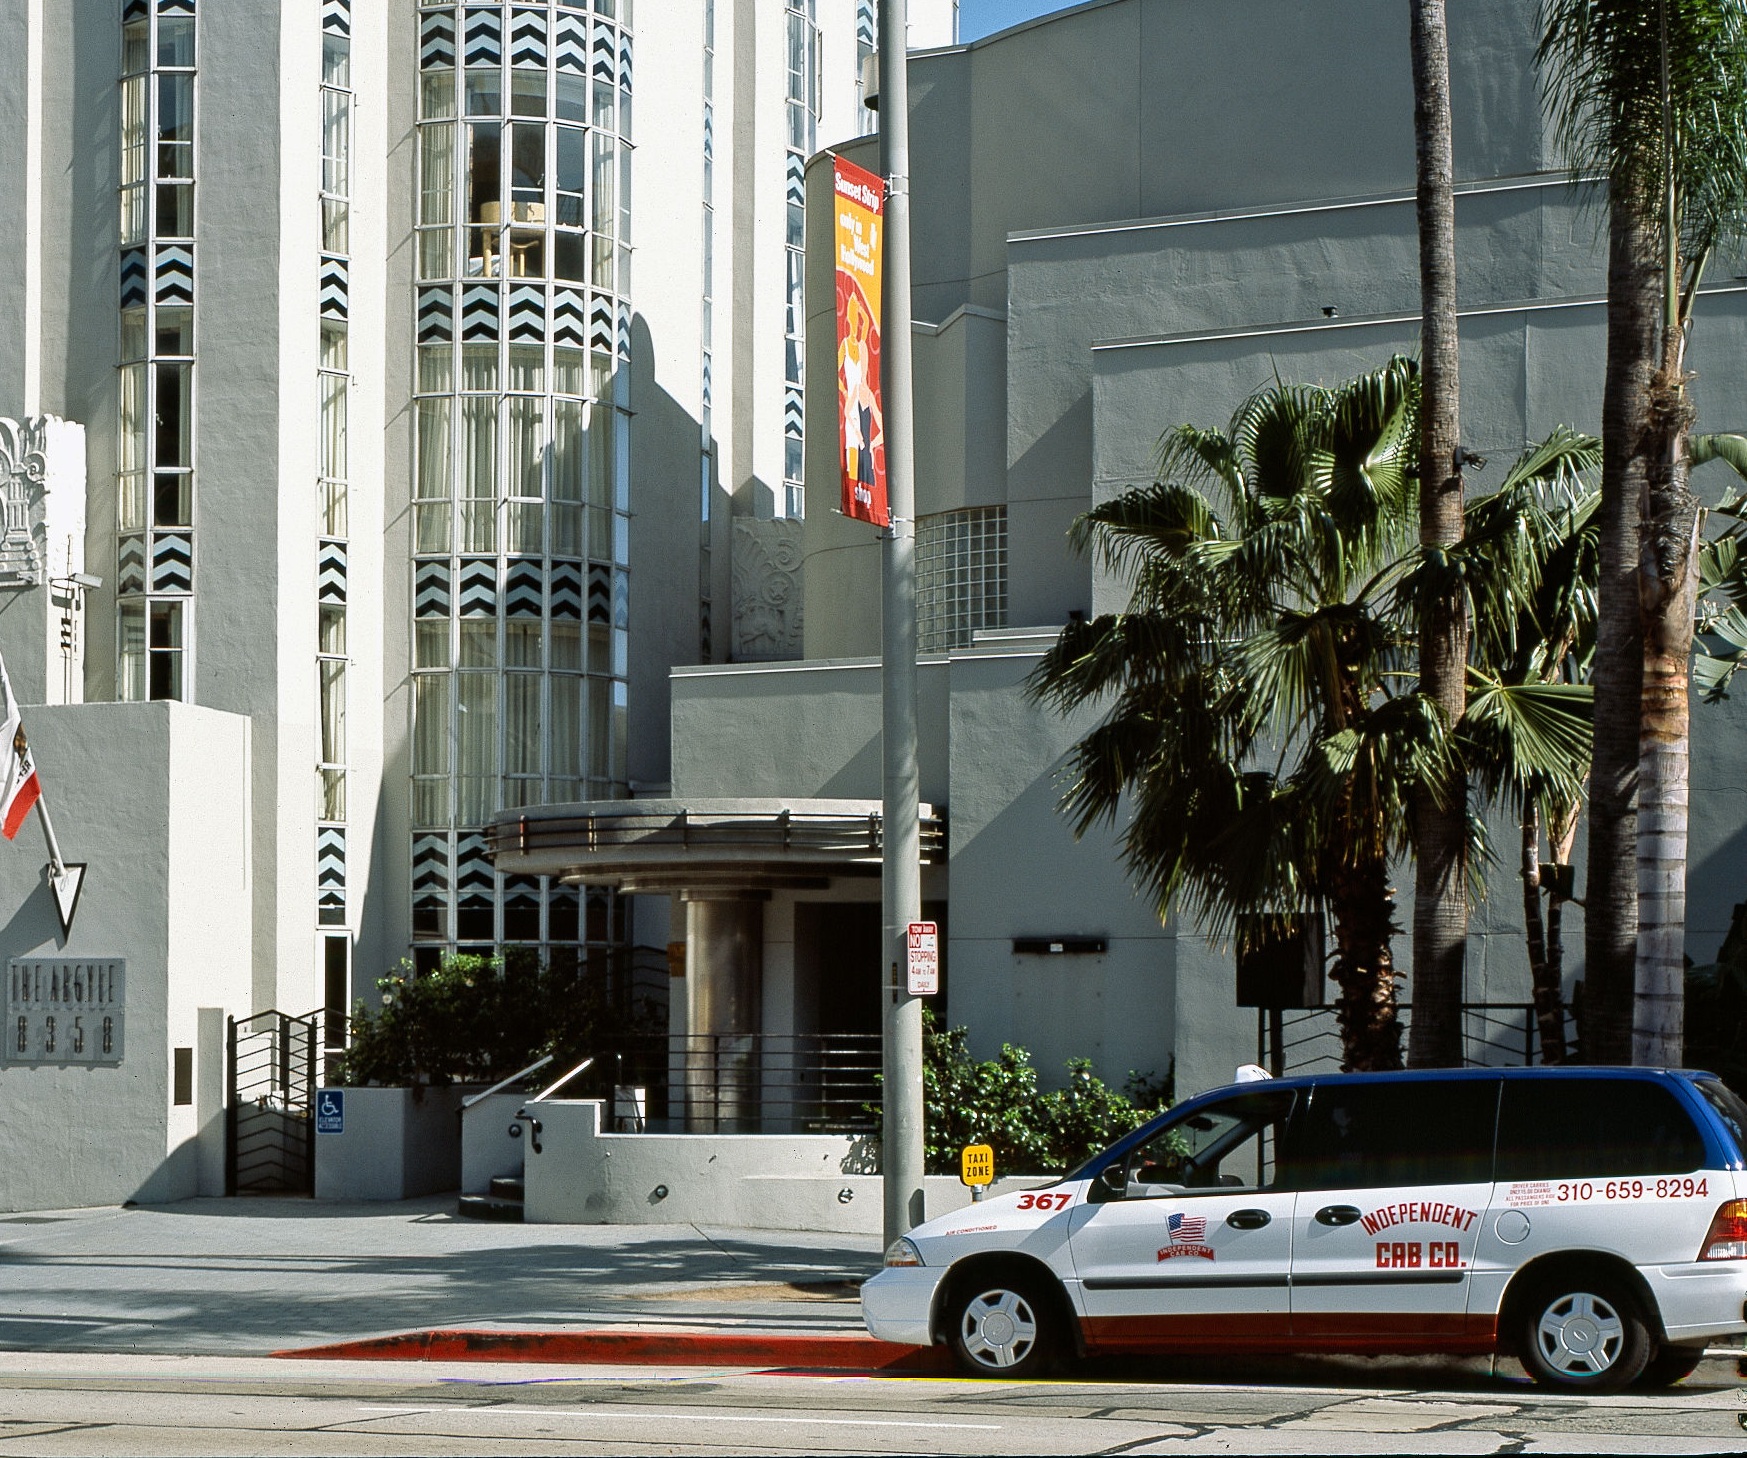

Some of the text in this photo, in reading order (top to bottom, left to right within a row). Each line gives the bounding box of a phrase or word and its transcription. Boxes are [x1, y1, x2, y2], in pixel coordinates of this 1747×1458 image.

[835, 172, 879, 213] Sunset Strip
[840, 212, 862, 235] only in
[854, 234, 869, 259] West
[841, 243, 874, 275] Hollywood
[854, 483, 871, 509] shop
[910, 934, 921, 947] NO
[910, 951, 936, 963] STOPPING
[12, 964, 114, 1002] THE ARGYLE
[968, 1153, 988, 1164] TAXI
[966, 1166, 990, 1177] ZONE
[1557, 1178, 1709, 1202] 310-659-8294
[1016, 1193, 1073, 1211] 367
[956, 1225, 998, 1235] CONDITIONED
[1359, 1202, 1478, 1236] INDEPENDENT
[1159, 1245, 1211, 1255] INDEPENDENT
[1376, 1242, 1467, 1268] CAB CO.
